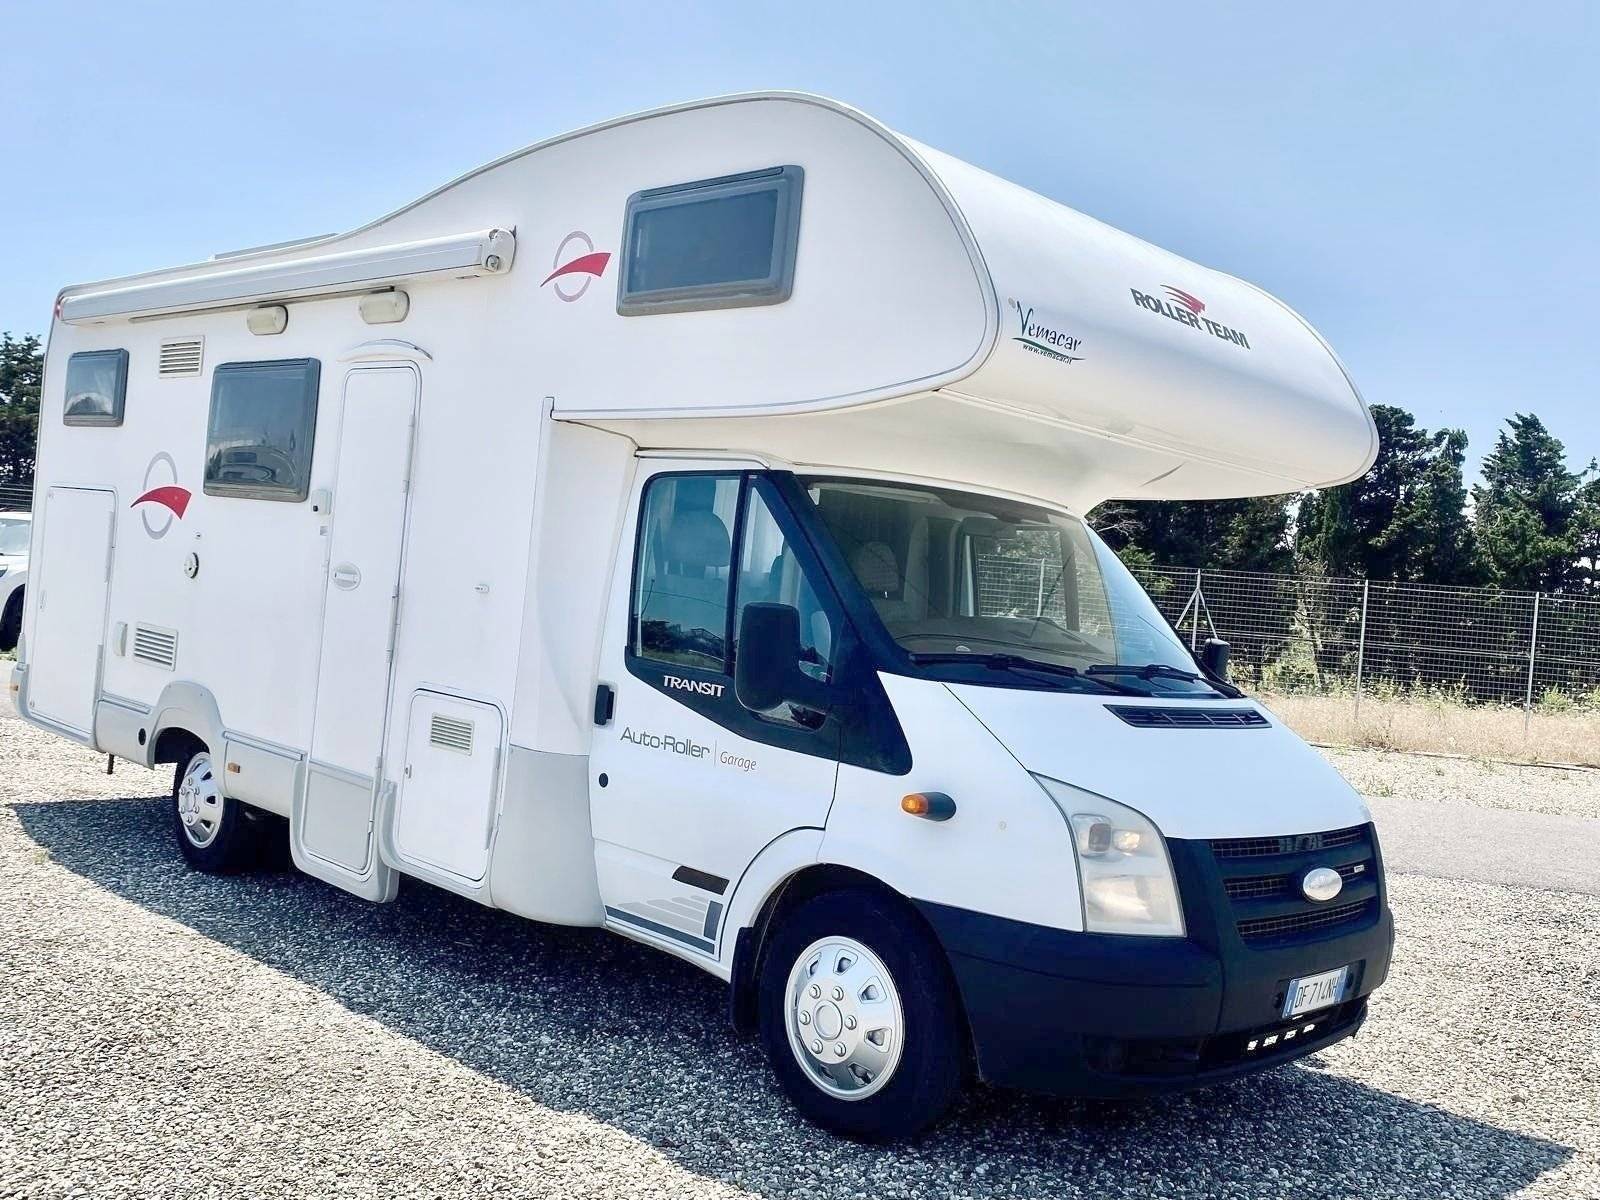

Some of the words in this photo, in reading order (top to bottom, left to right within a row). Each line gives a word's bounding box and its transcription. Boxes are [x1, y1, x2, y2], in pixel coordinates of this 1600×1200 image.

[1016, 300, 1082, 351] Vemacar
[1130, 287, 1203, 330] ROLLER
[1200, 316, 1251, 350] TEAM
[1022, 344, 1072, 365] www.vemacar.it
[663, 675, 725, 697] TRANSIT
[720, 751, 757, 772] Garage
